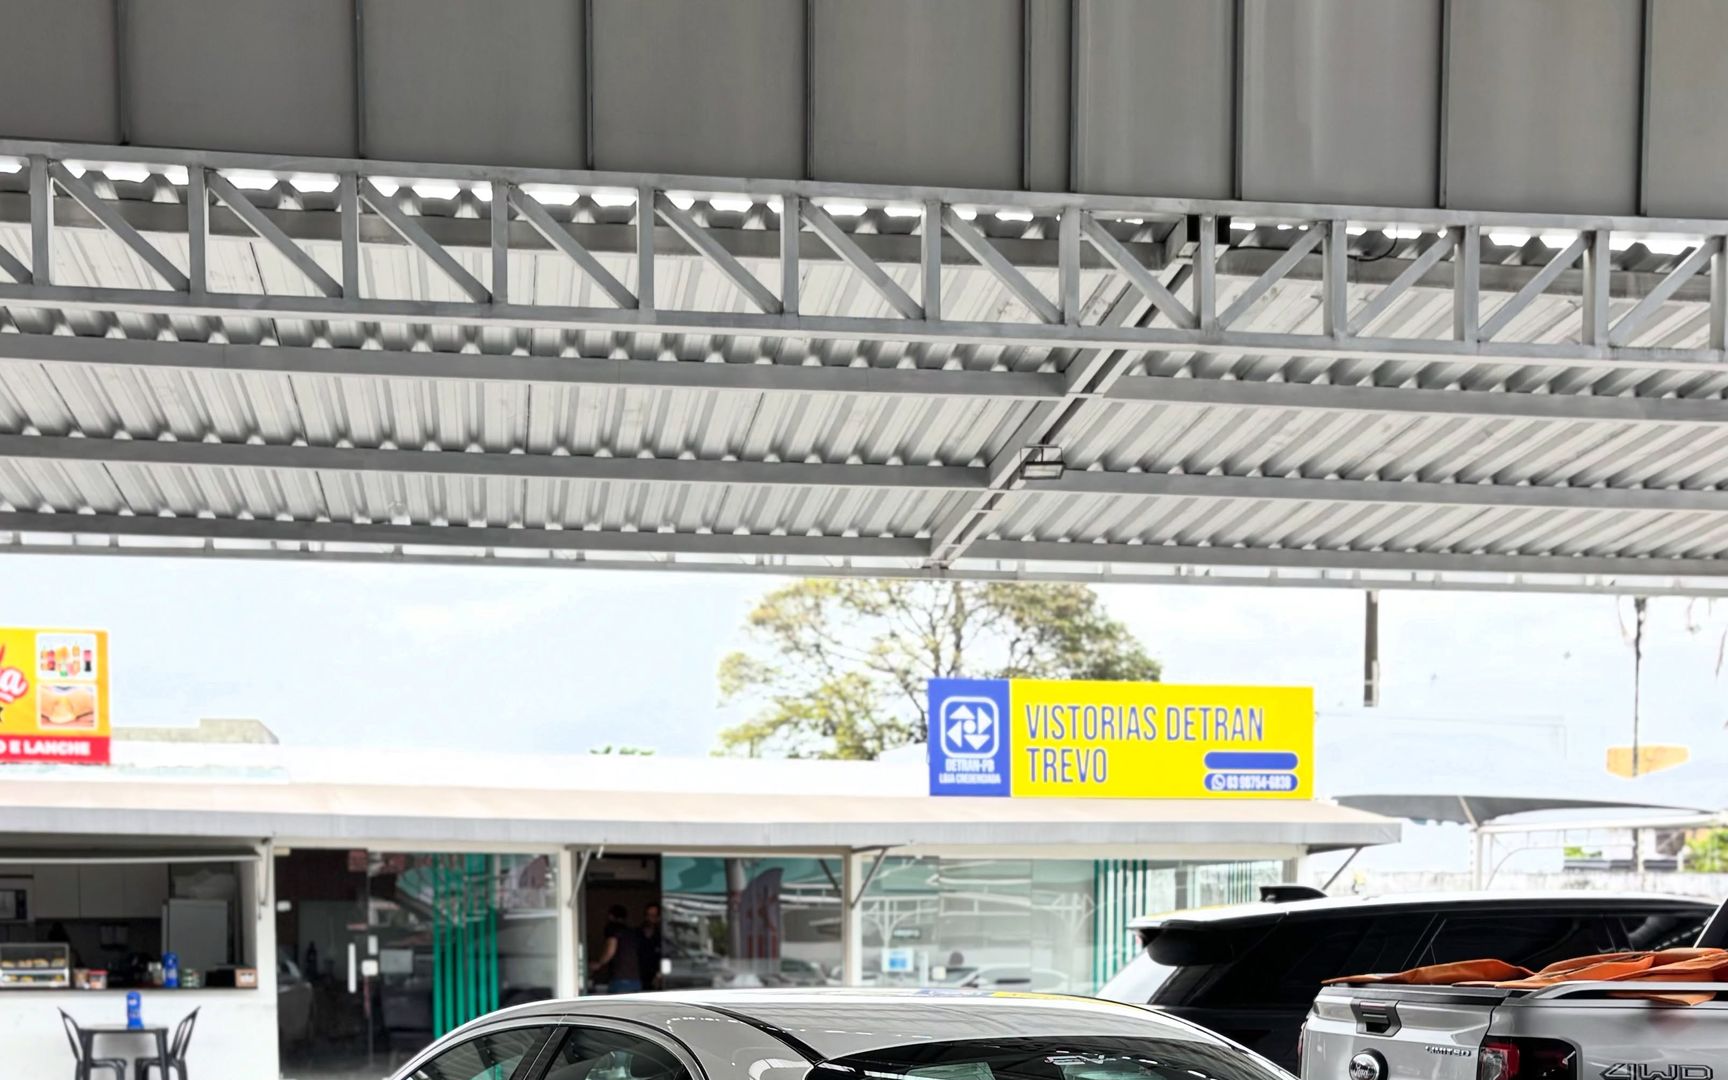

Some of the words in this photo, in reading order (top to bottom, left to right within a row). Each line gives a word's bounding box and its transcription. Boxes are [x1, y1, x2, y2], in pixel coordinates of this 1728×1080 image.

[1026, 705, 1157, 741] VISTORIAS
[1166, 707, 1264, 742] DETRAN
[24, 740, 90, 756] LANCHE
[1026, 747, 1107, 784] TREVO
